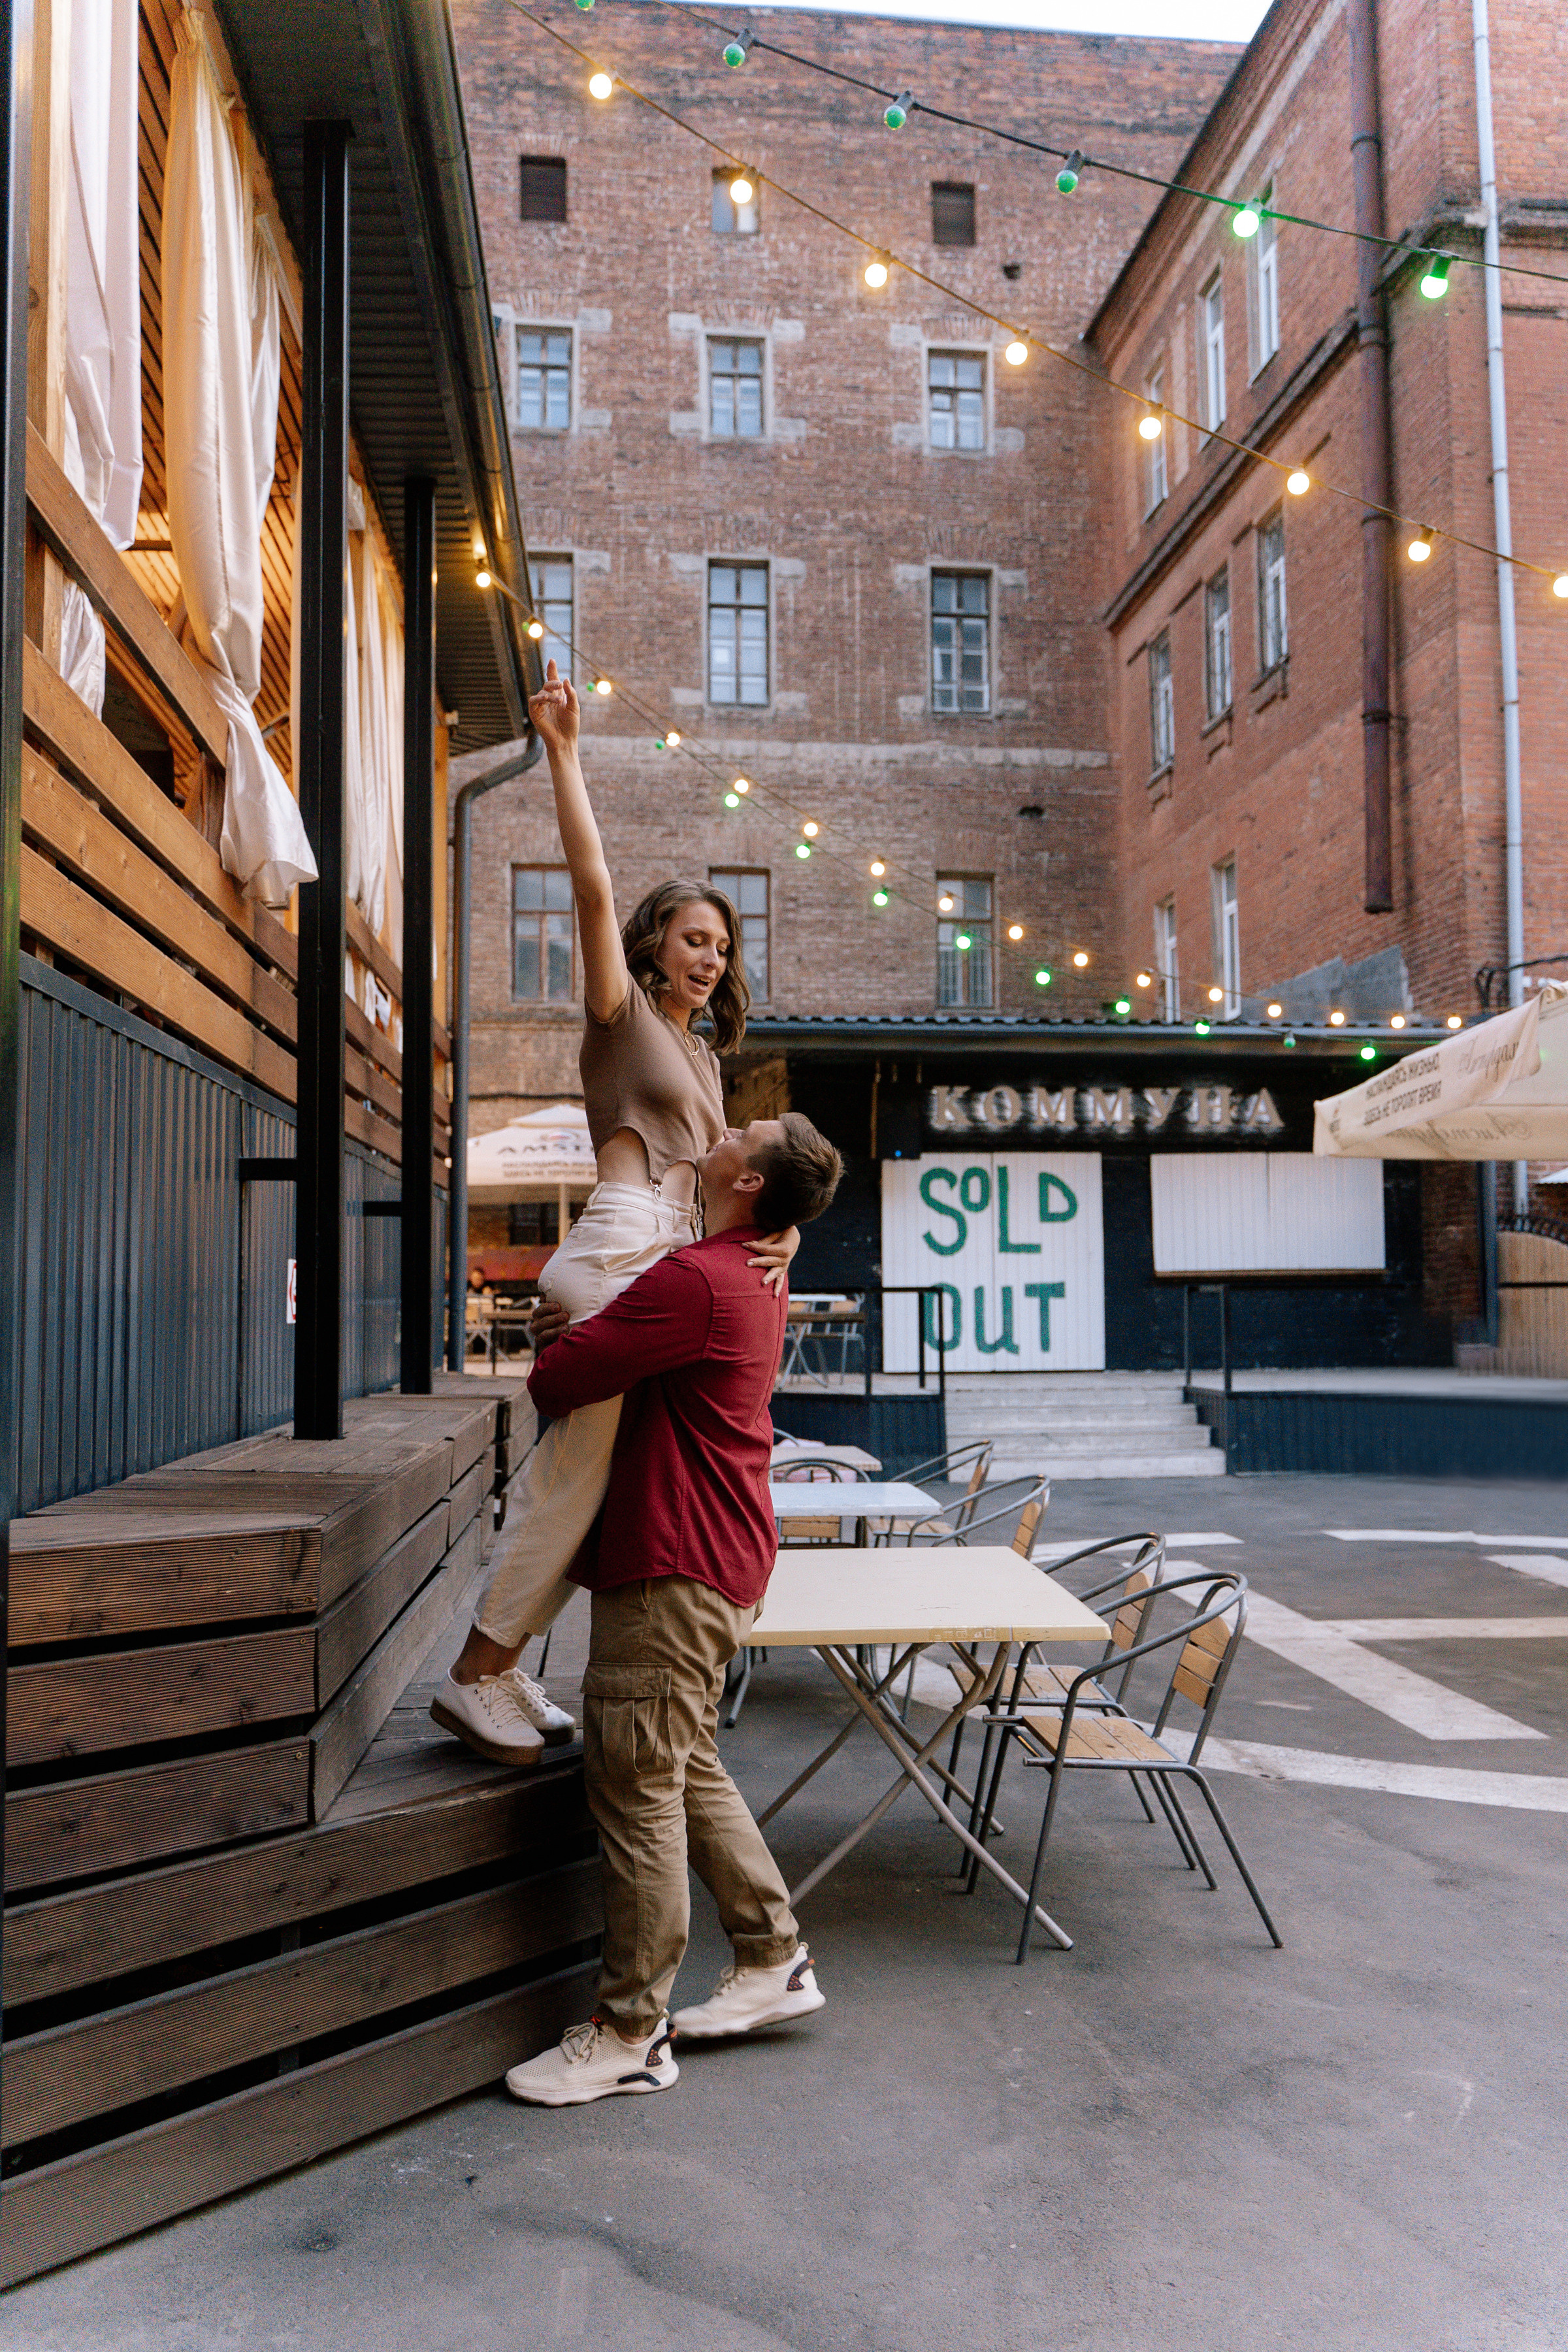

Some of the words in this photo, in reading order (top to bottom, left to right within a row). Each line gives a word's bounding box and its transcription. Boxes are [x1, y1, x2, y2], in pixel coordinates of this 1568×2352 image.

[926, 1085, 1285, 1129] КОММУНА
[919, 1166, 1077, 1256] SOLD
[923, 1282, 1065, 1354] OUT
